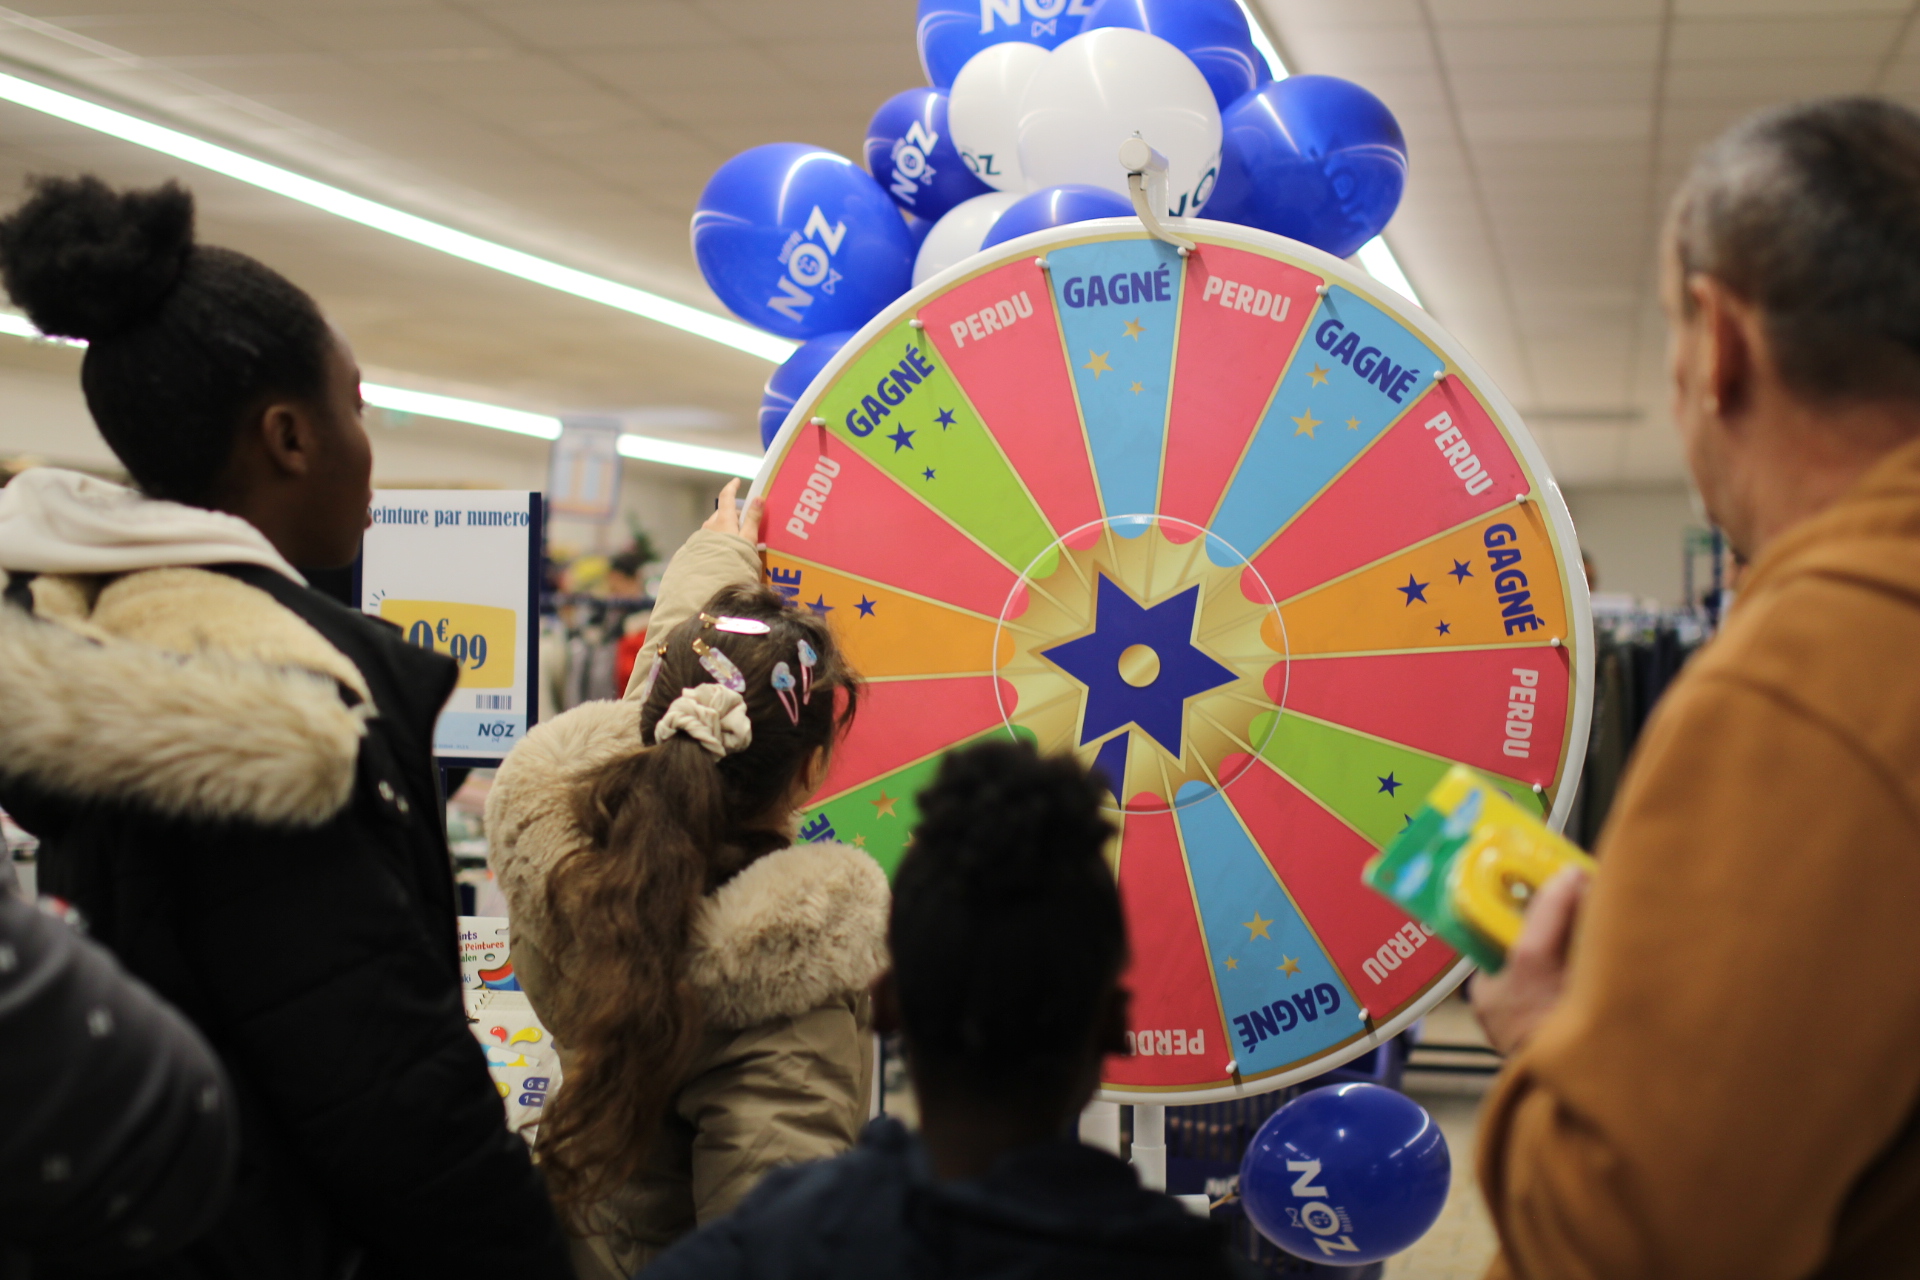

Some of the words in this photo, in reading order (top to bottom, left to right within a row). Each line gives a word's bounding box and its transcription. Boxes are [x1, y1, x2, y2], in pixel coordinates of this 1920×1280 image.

[890, 120, 939, 206] NOZ
[767, 204, 847, 323] NOZ
[1063, 263, 1172, 308] GAGNÉ
[1202, 275, 1291, 323] PERDU
[949, 290, 1034, 349] PERDU
[1314, 318, 1421, 405] GAGNÉ
[845, 343, 936, 438] GAGNÉ
[1423, 411, 1494, 497] PERDU
[367, 506, 429, 525] einture
[434, 509, 462, 528] par
[467, 509, 530, 527] numero
[785, 455, 841, 541] PERDU
[1483, 522, 1545, 637] GAGNÉ
[478, 723, 515, 738] NOZ
[1502, 667, 1539, 759] PERDU
[465, 941, 505, 952] Peintures
[1232, 982, 1342, 1054] GAGNÉ
[1286, 1158, 1360, 1256] NOZ
